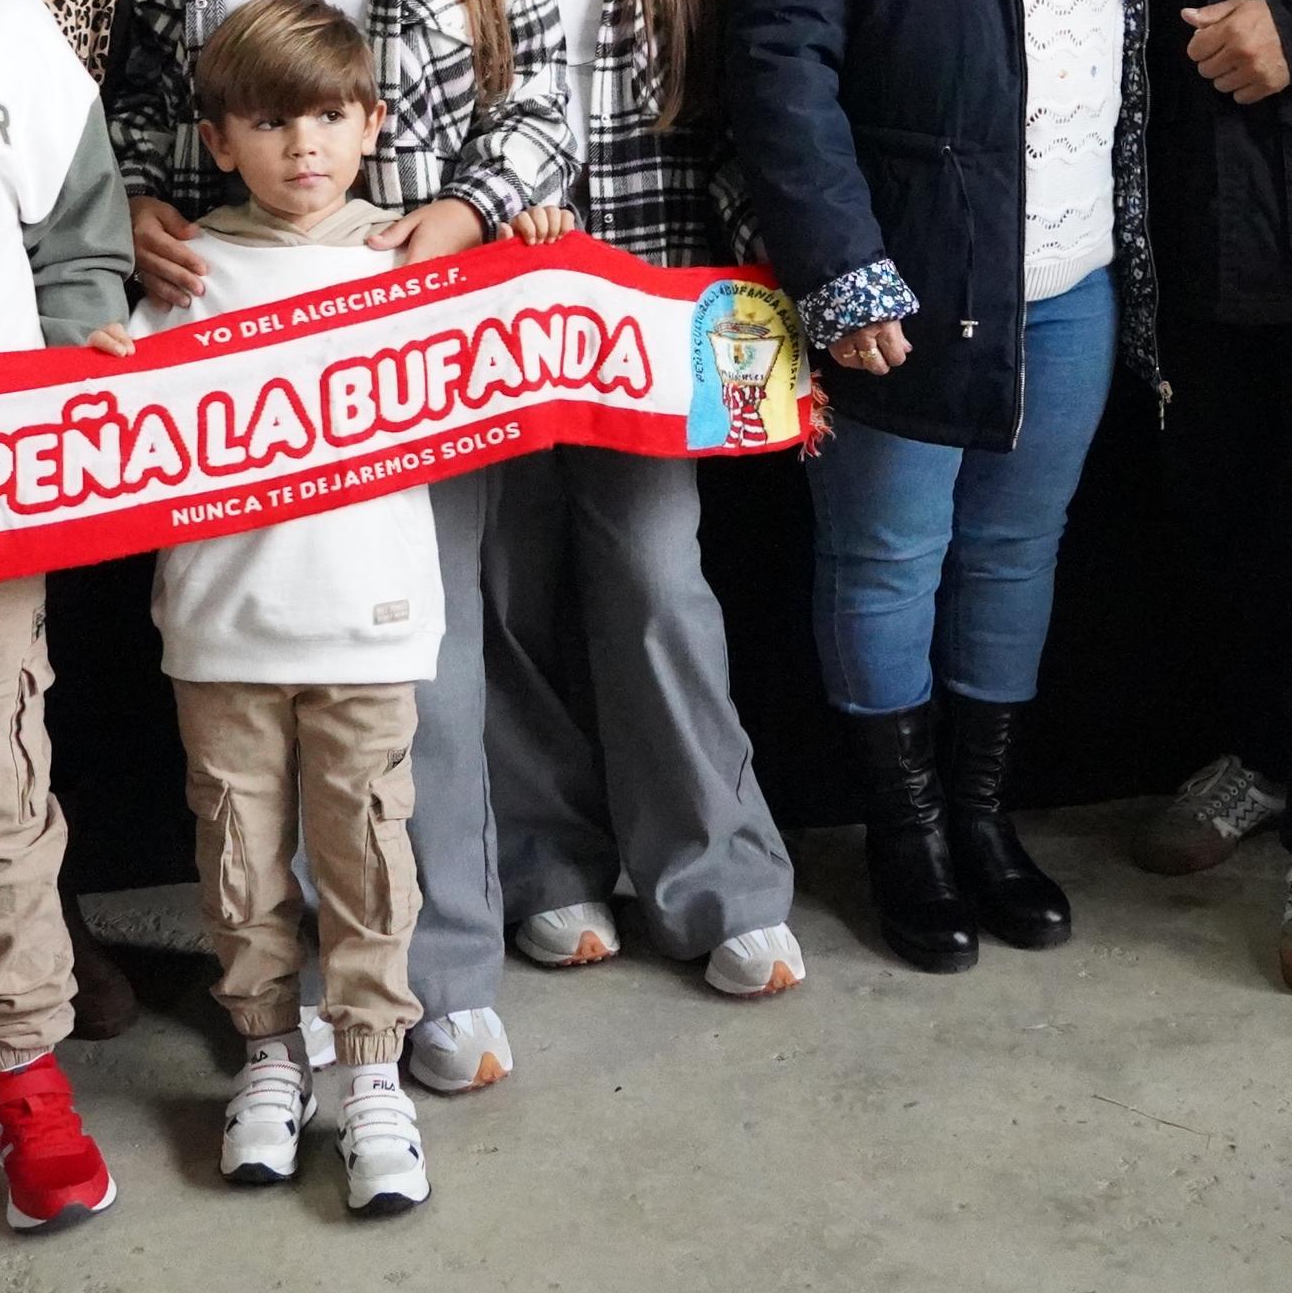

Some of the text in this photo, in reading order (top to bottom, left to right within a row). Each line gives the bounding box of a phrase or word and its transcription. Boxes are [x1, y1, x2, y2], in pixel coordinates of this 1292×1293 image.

[194, 267, 468, 348] YO DEL ALGECIRAS C.F.
[198, 378, 316, 477] LA
[320, 304, 653, 448] BUFANDA
[171, 421, 522, 527] NUNCA TE DEJAREMOS SOLOS
[372, 1078, 396, 1092] FILA
